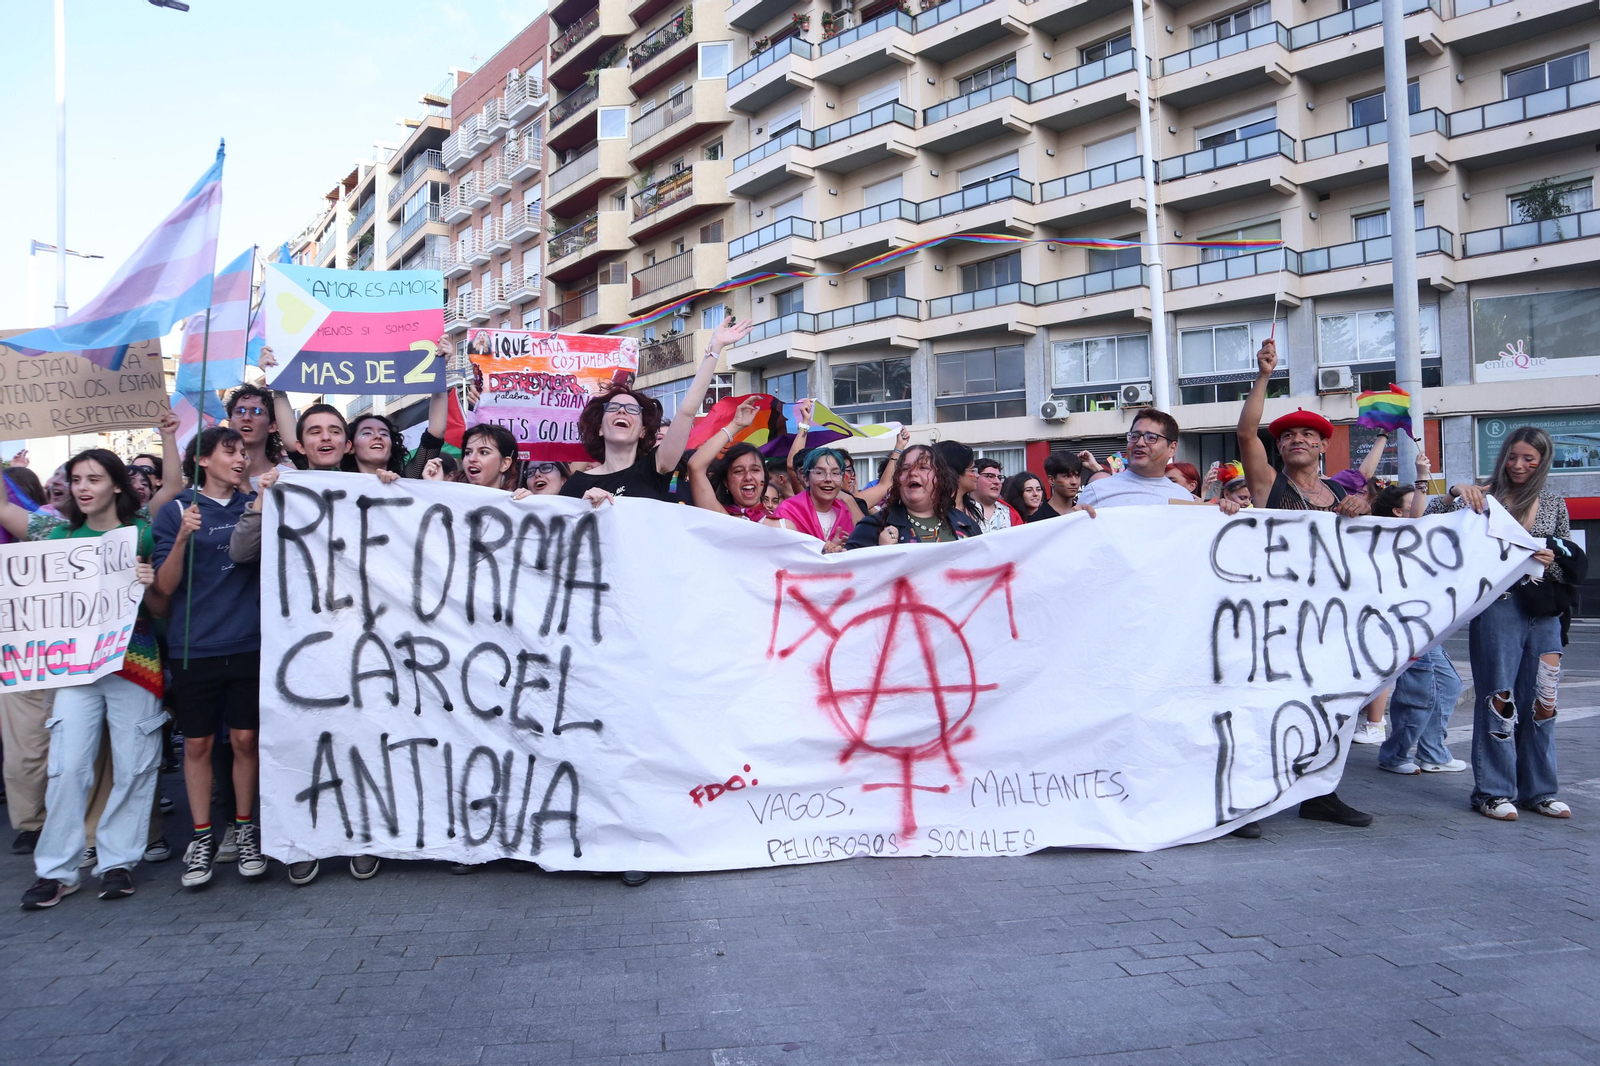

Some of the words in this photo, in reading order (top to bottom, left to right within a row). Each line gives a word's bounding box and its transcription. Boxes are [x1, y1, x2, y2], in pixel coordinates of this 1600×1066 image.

[365, 282, 385, 297] ES
[317, 326, 353, 337] MENOS
[361, 327, 370, 335] SI
[384, 322, 419, 335] SOMOS
[17, 356, 78, 380] ESTÁN
[301, 360, 355, 385] MAS
[365, 360, 396, 384] DE
[403, 340, 438, 384] 2
[551, 352, 619, 370] COSTUMBRE
[1484, 354, 1547, 369] enfoQue
[0, 379, 111, 405] TENDERLOS.
[119, 371, 162, 392] ESTÁN
[540, 391, 597, 410] LESBIAN
[50, 400, 169, 429] RESPETARLOS
[538, 419, 559, 442] GO
[0, 540, 136, 587] UESTRA
[270, 483, 611, 645] REFORMA
[1209, 515, 1464, 594] CENTRO
[295, 730, 583, 858] ANTIGUA
[747, 786, 854, 825] VAGOS,
[971, 769, 1129, 807] MALEANTES,
[767, 833, 900, 862] PELIGROSOS
